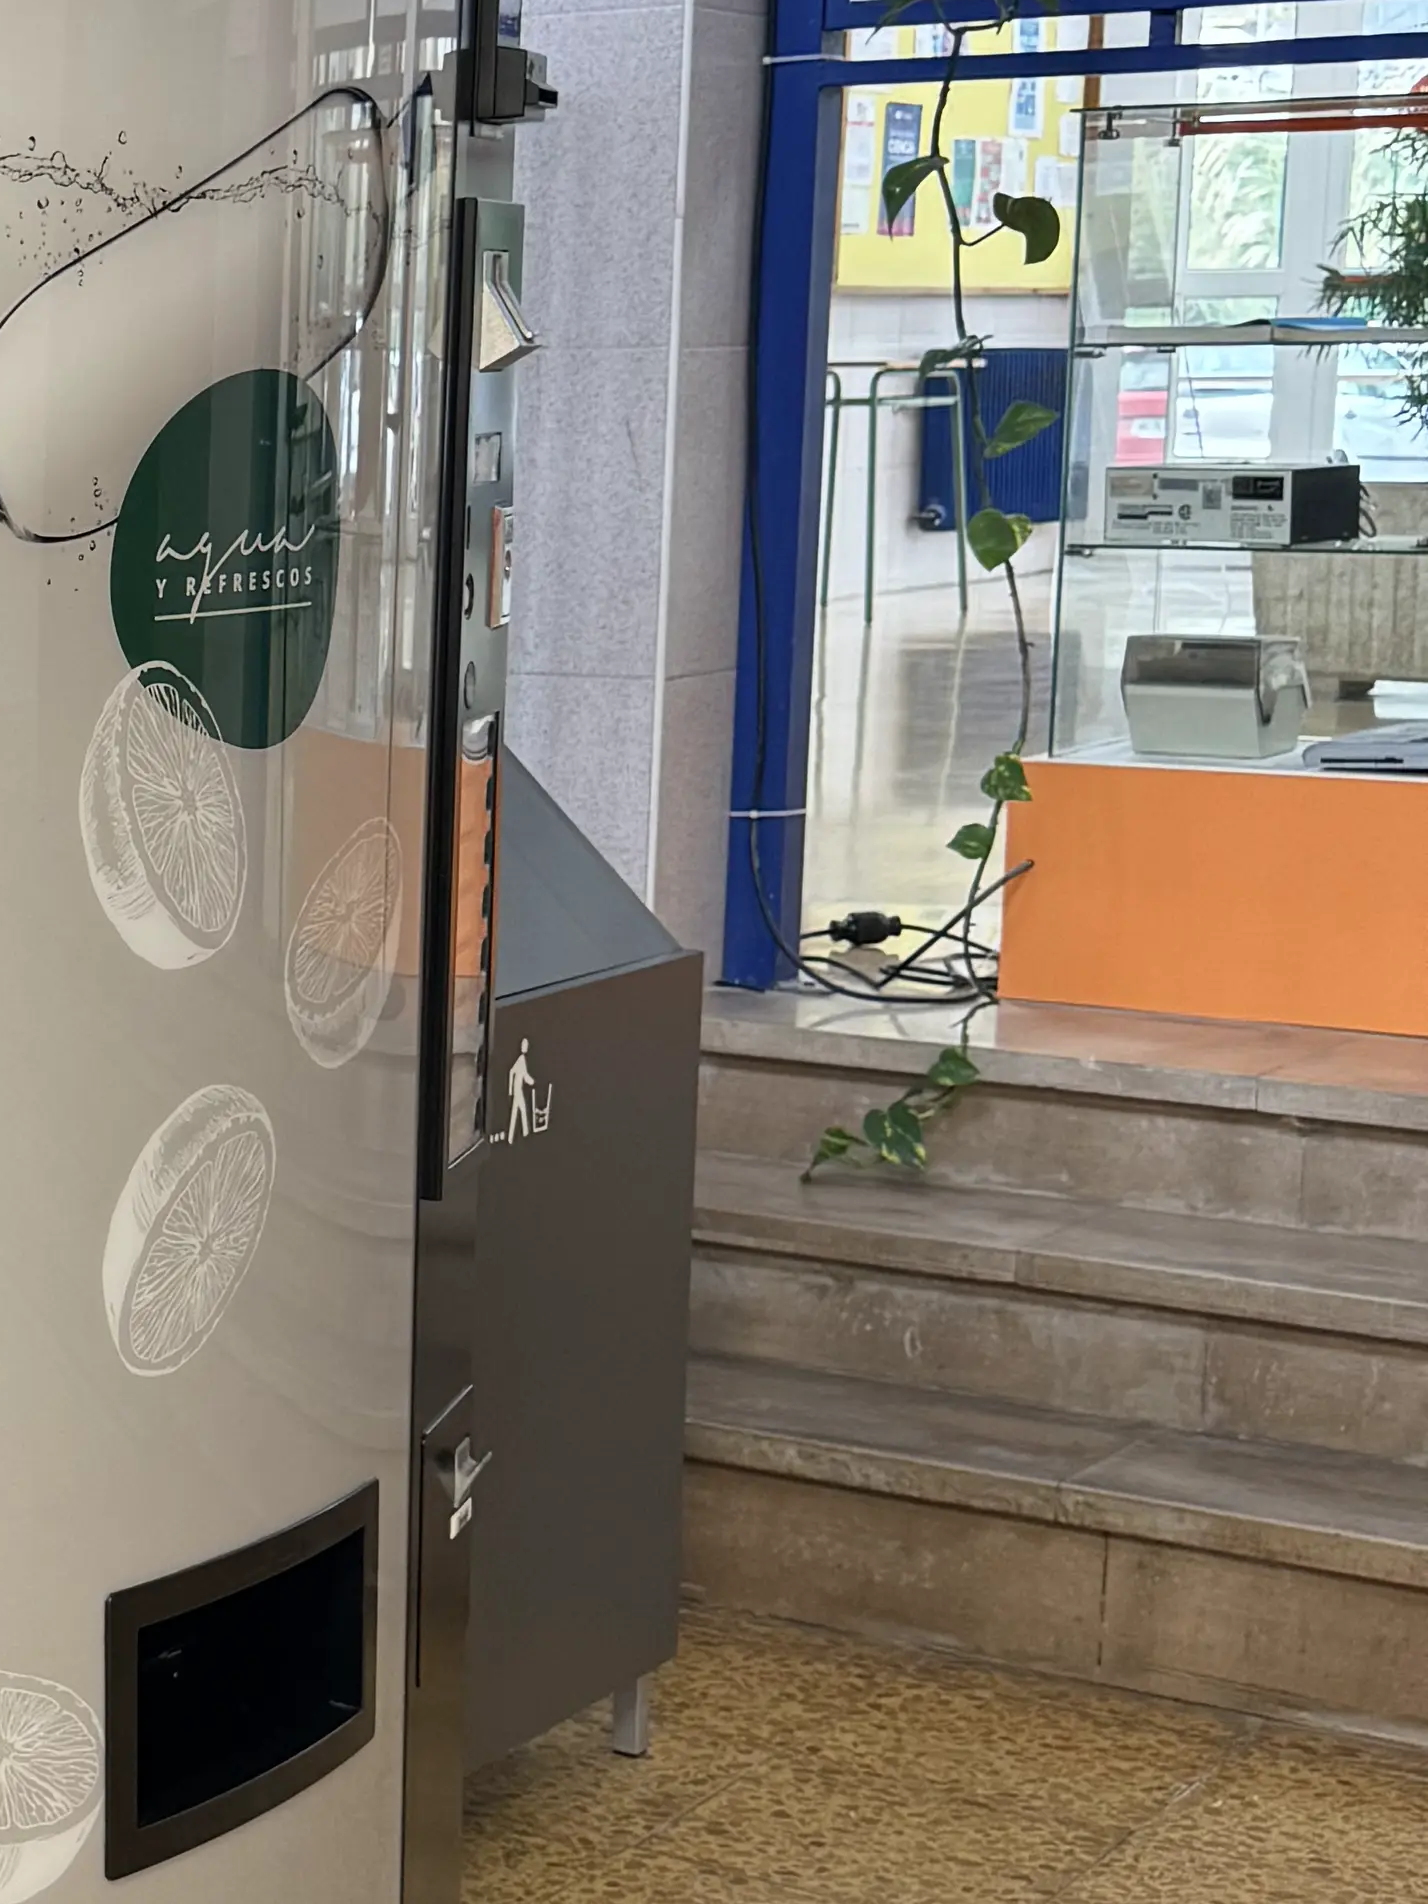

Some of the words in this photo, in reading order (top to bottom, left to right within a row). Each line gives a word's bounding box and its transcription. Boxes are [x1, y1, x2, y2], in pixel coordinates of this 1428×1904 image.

[155, 523, 316, 625] agua
[155, 578, 169, 600] Y
[185, 566, 313, 599] REFRESCOS
